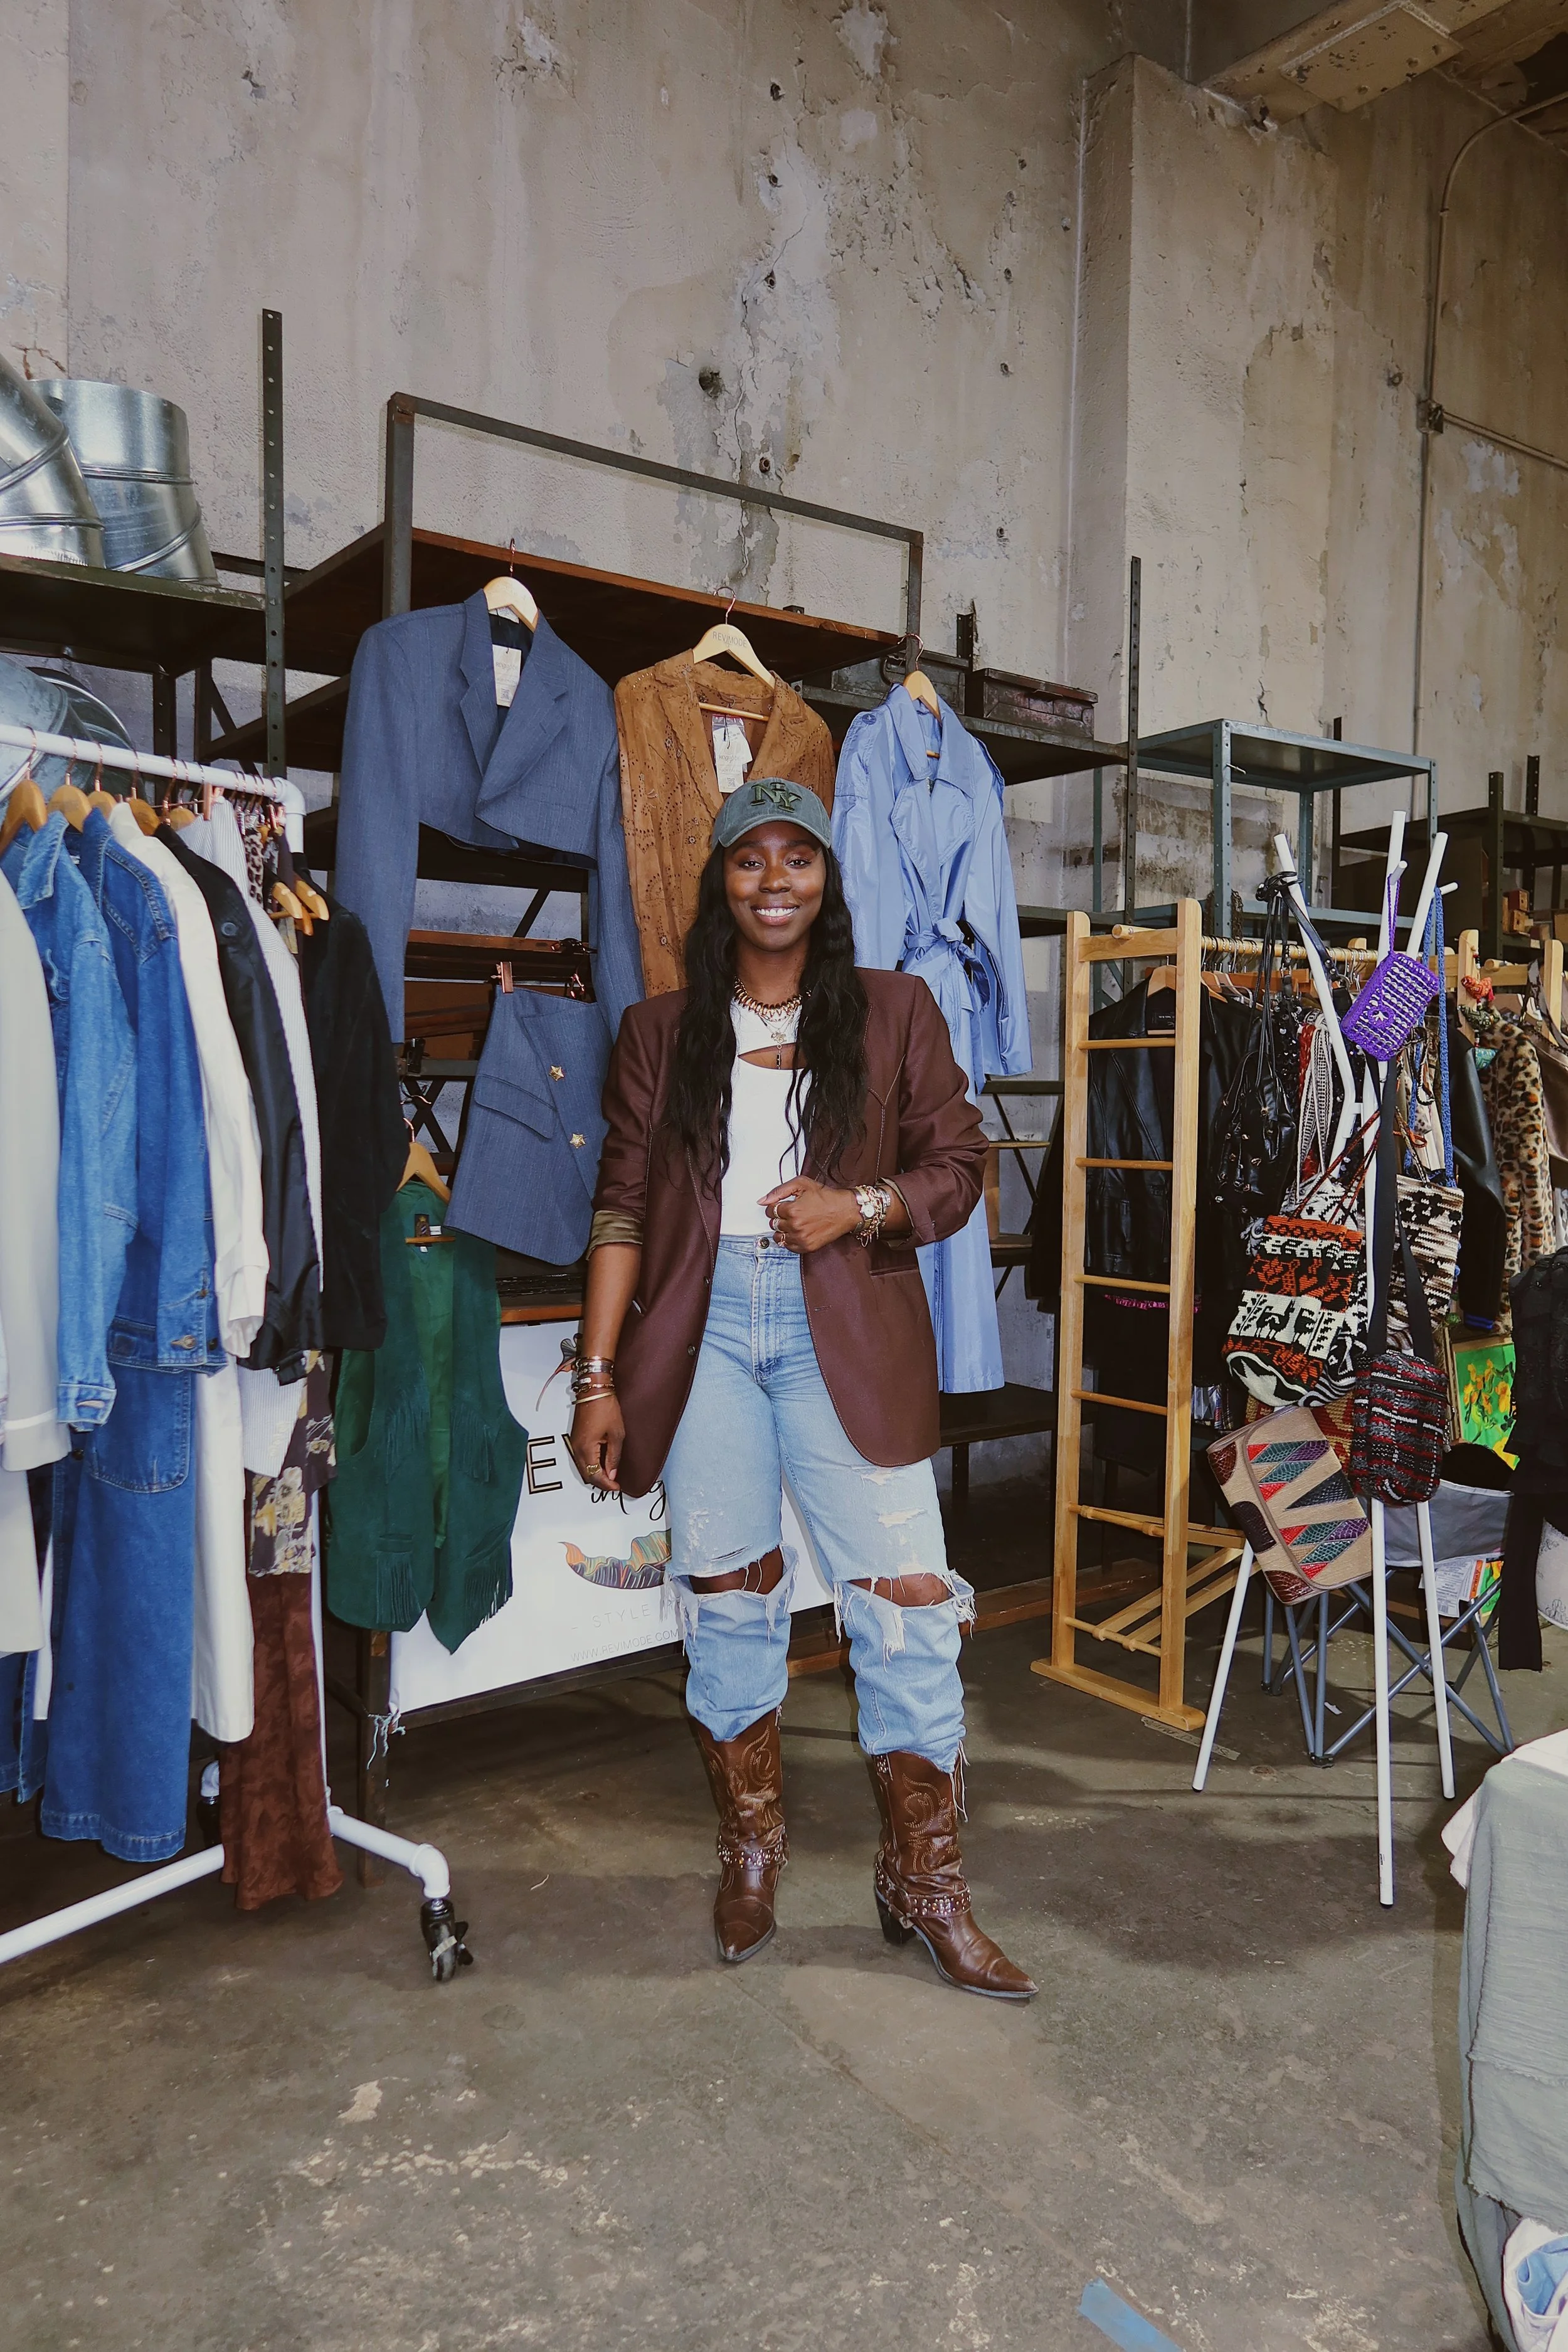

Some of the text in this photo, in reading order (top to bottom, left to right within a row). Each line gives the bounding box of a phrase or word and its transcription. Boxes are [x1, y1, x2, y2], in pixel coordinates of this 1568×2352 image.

[712, 631, 747, 647] REVIMODE
[750, 781, 802, 813] NY
[592, 1604, 652, 1628] STYLE
